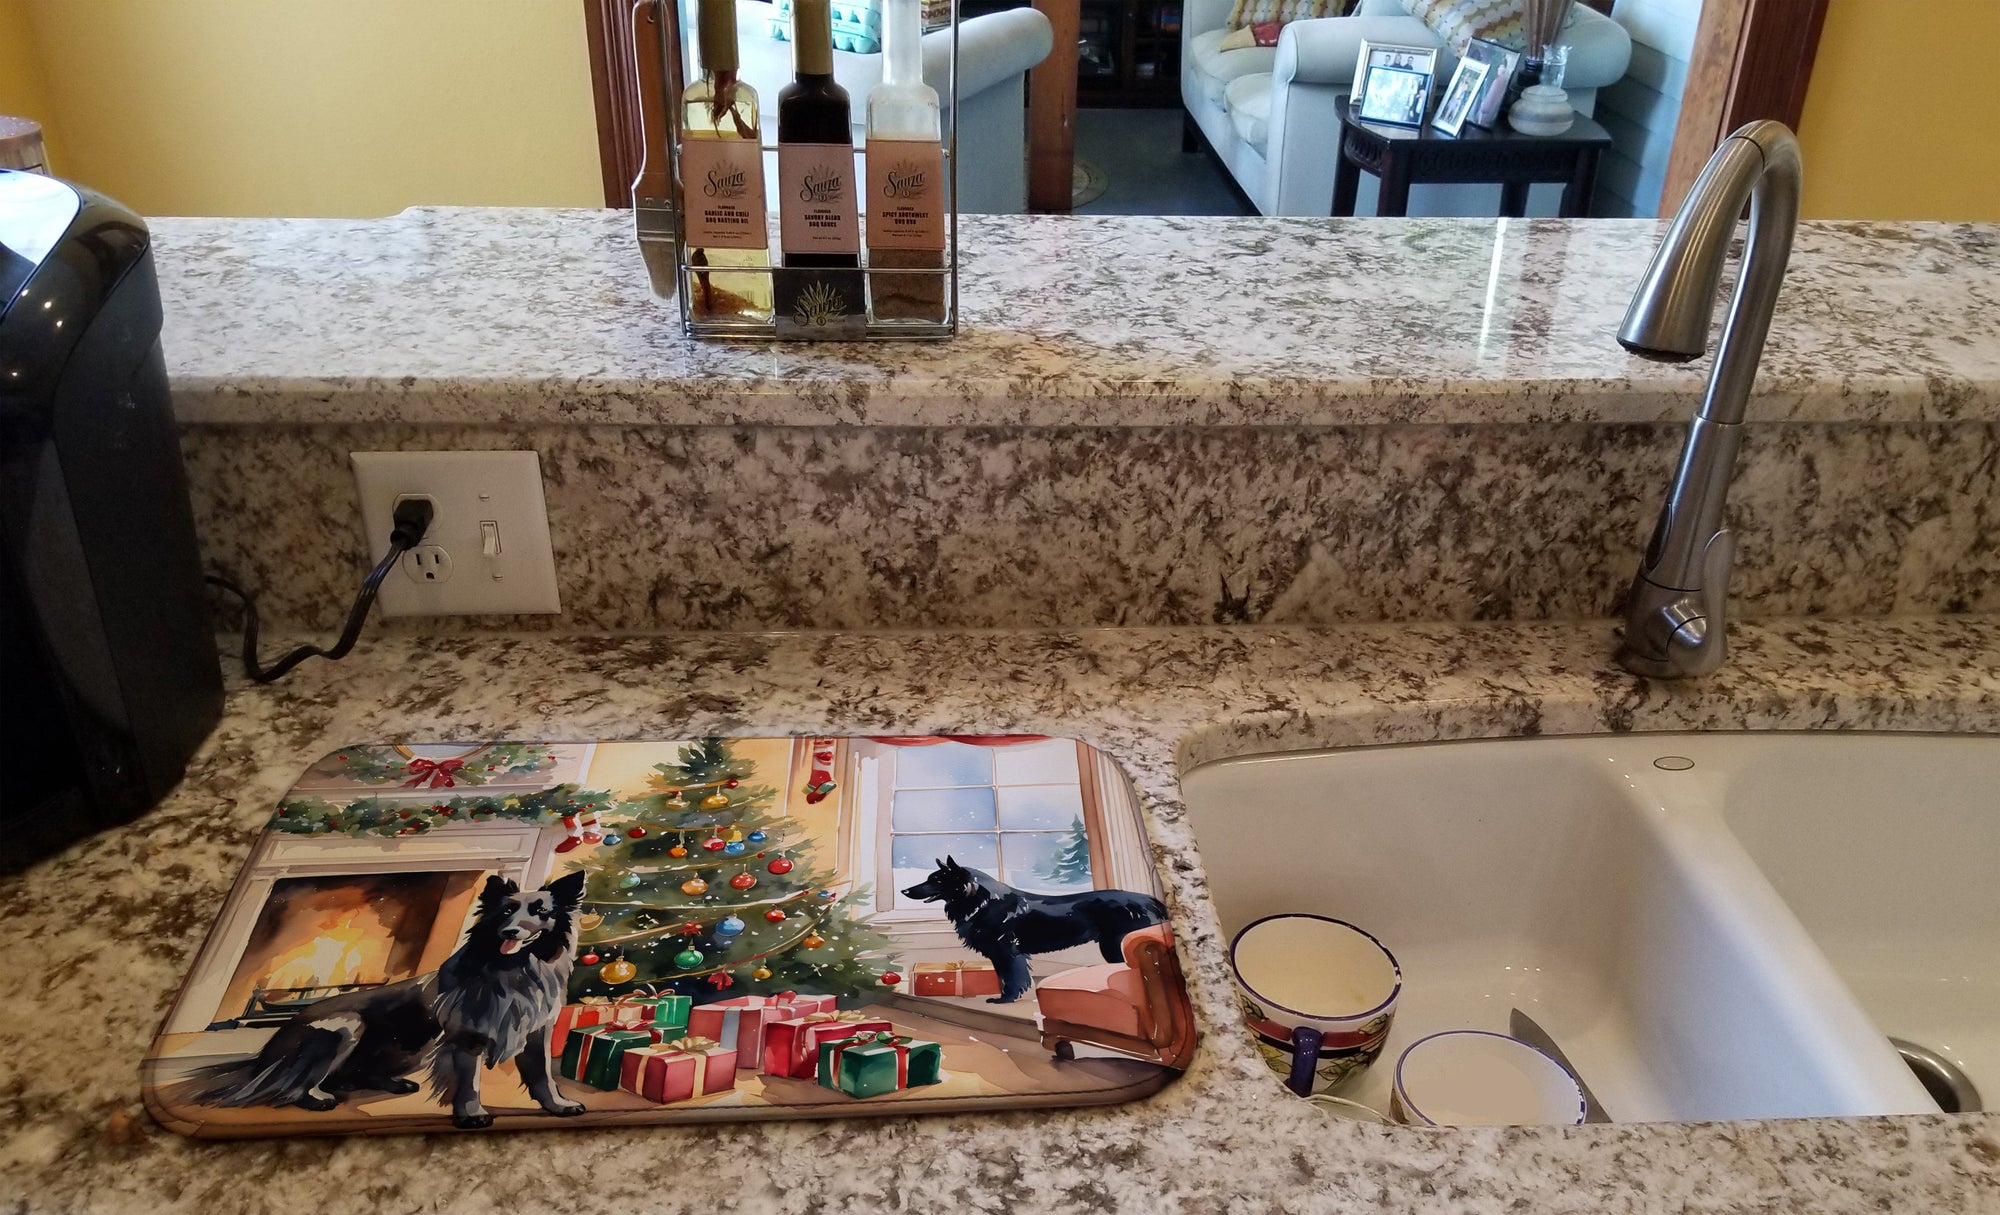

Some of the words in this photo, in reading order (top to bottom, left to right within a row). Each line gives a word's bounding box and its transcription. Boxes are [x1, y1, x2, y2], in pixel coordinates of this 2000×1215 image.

[703, 170, 745, 197] Sauza
[800, 175, 841, 202] Sauza
[884, 171, 924, 198] Sauza
